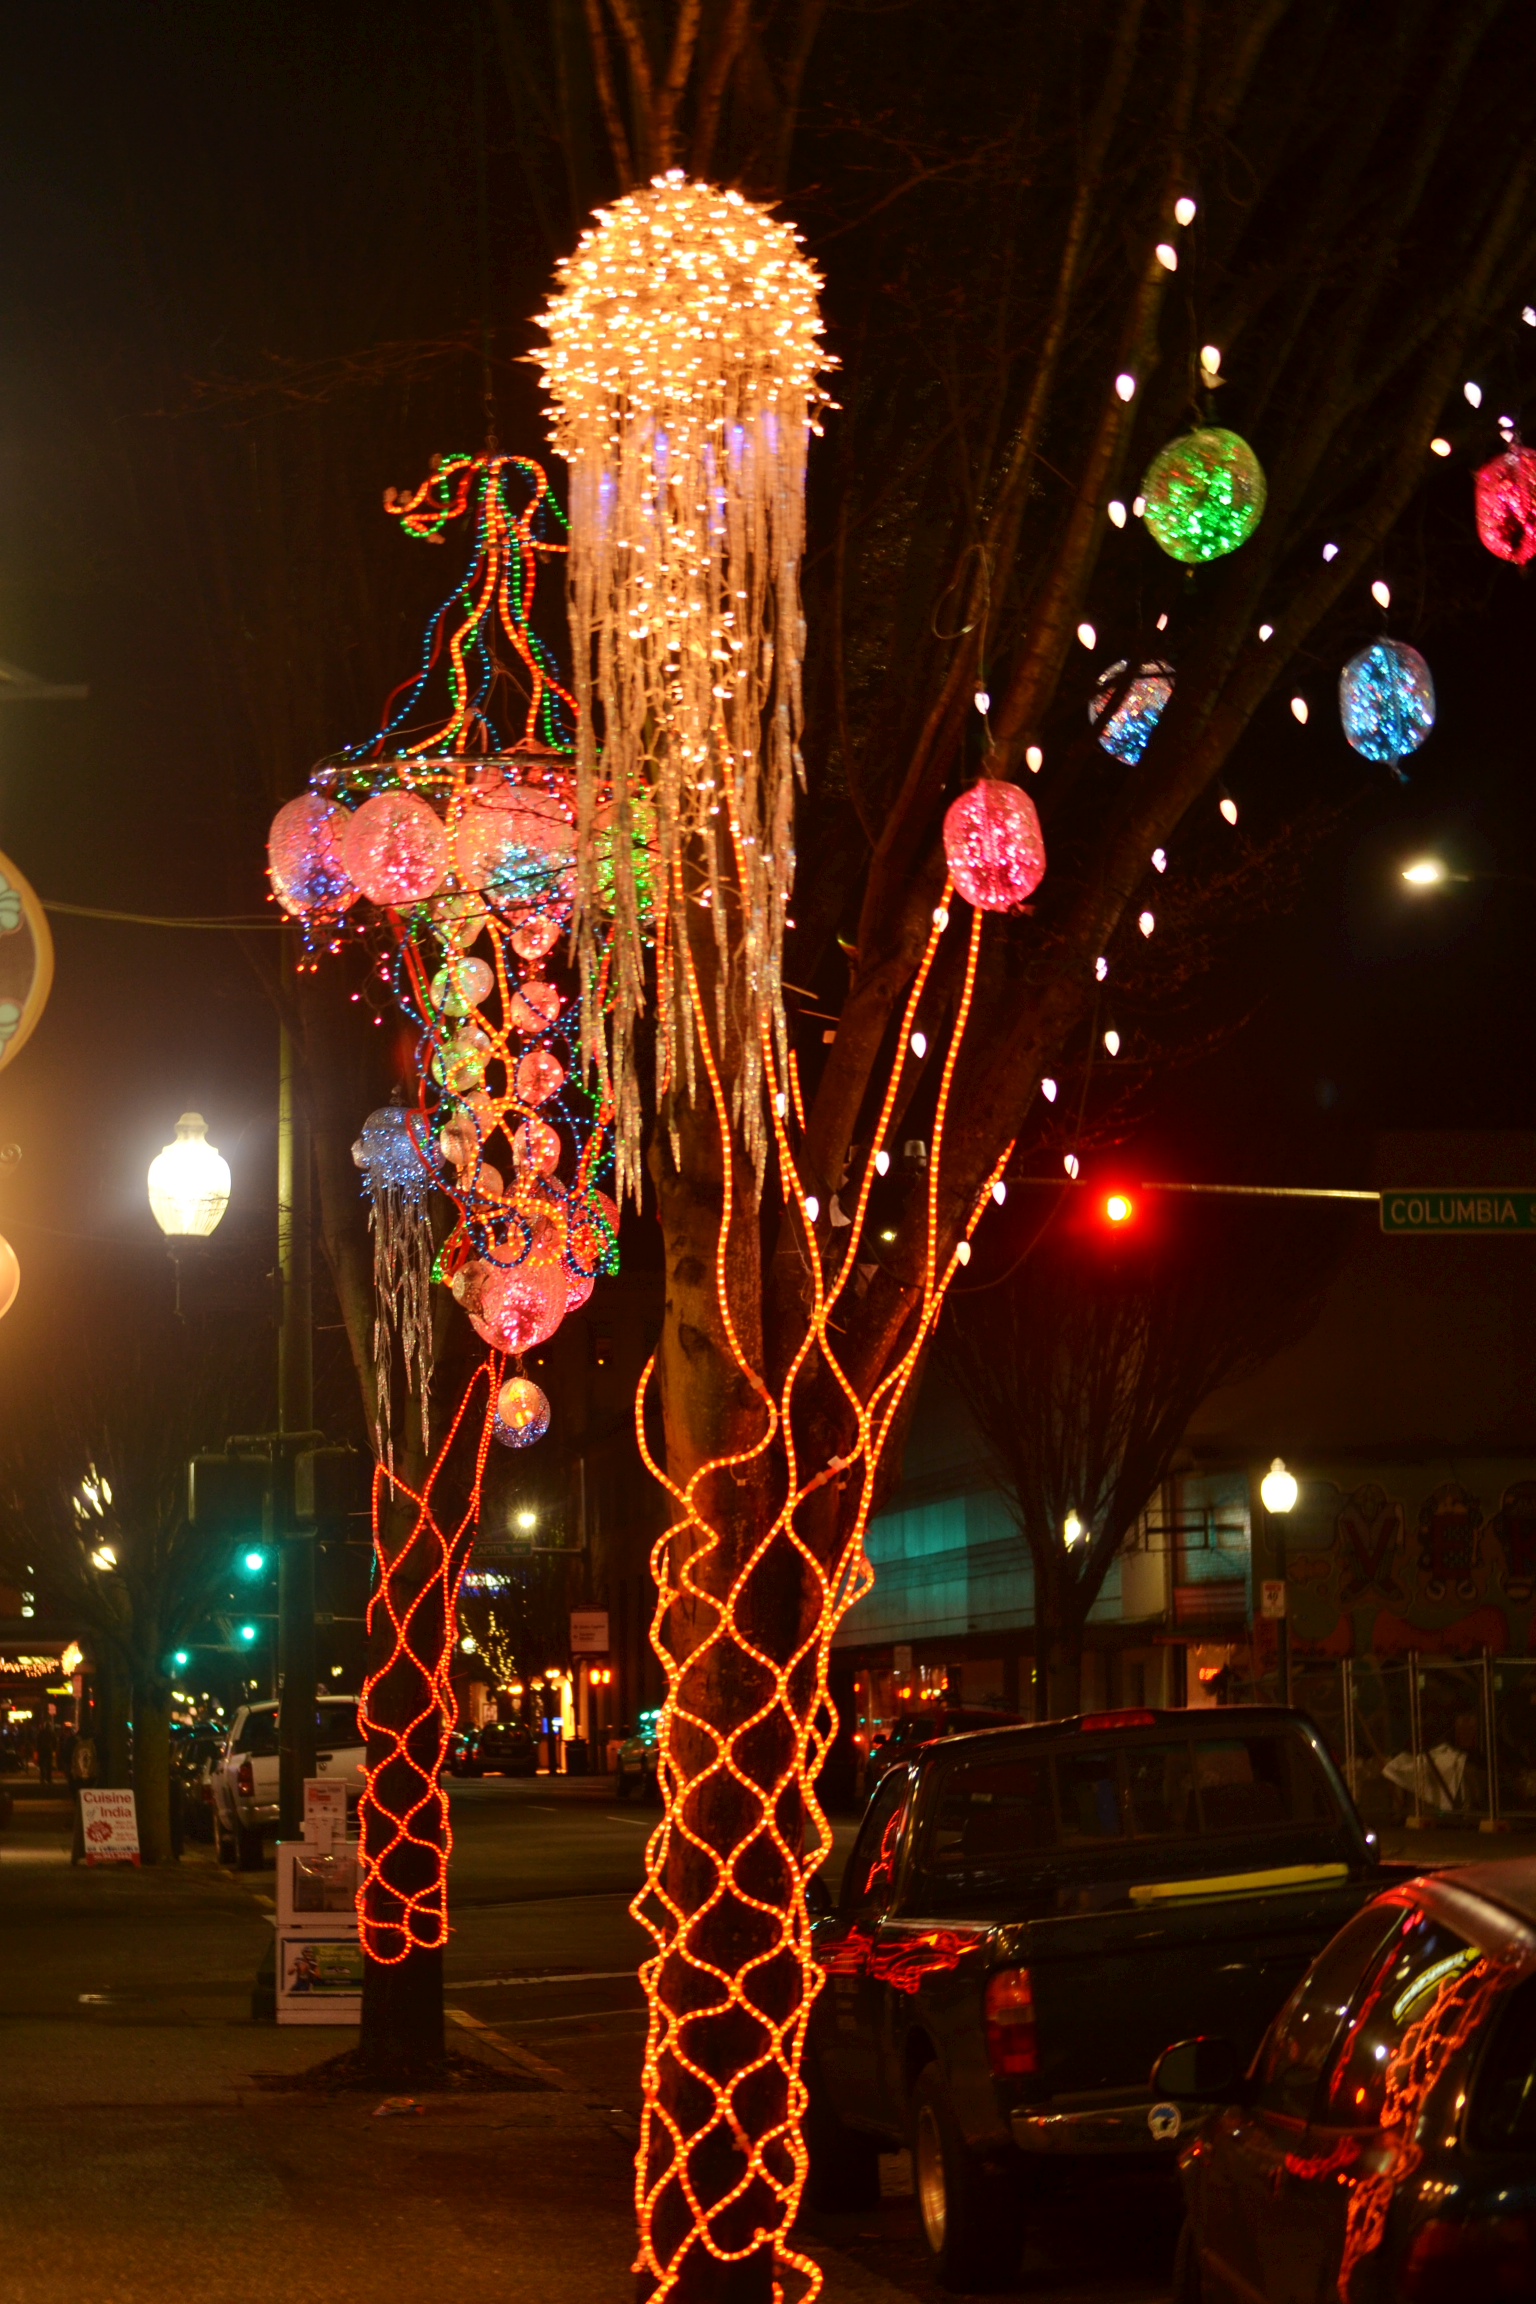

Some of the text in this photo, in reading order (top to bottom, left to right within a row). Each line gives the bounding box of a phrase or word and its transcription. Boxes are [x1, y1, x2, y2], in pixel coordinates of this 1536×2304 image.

[1390, 1199, 1518, 1225] COLUMBIA
[83, 1791, 132, 1804] Cuisine
[100, 1806, 132, 1818] India
